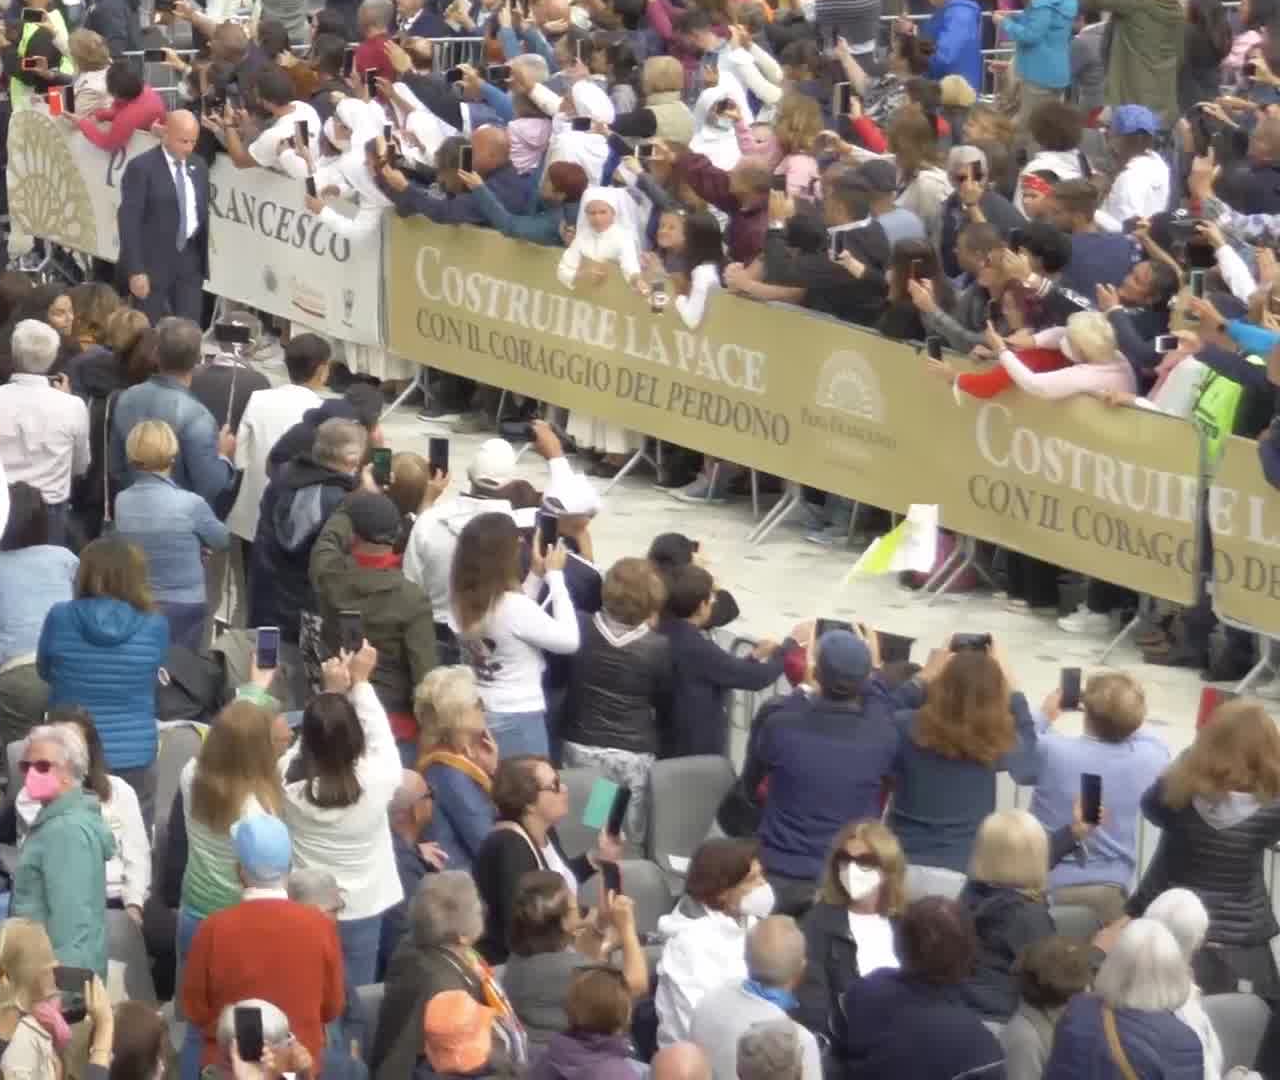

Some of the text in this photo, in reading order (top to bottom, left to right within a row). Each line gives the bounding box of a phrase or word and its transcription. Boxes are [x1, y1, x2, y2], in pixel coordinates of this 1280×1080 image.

[207, 183, 352, 264] RANCESCO
[415, 245, 768, 395] COSTRUIRE LA PACE
[416, 308, 465, 346] CON
[466, 320, 487, 351] IL
[487, 328, 611, 392] CORAGGIO
[614, 369, 662, 411] DEL
[665, 380, 791, 448] PERDONO
[968, 474, 1035, 521] CON
[1036, 494, 1065, 533] IL
[1071, 504, 1235, 585] CORAGGO
